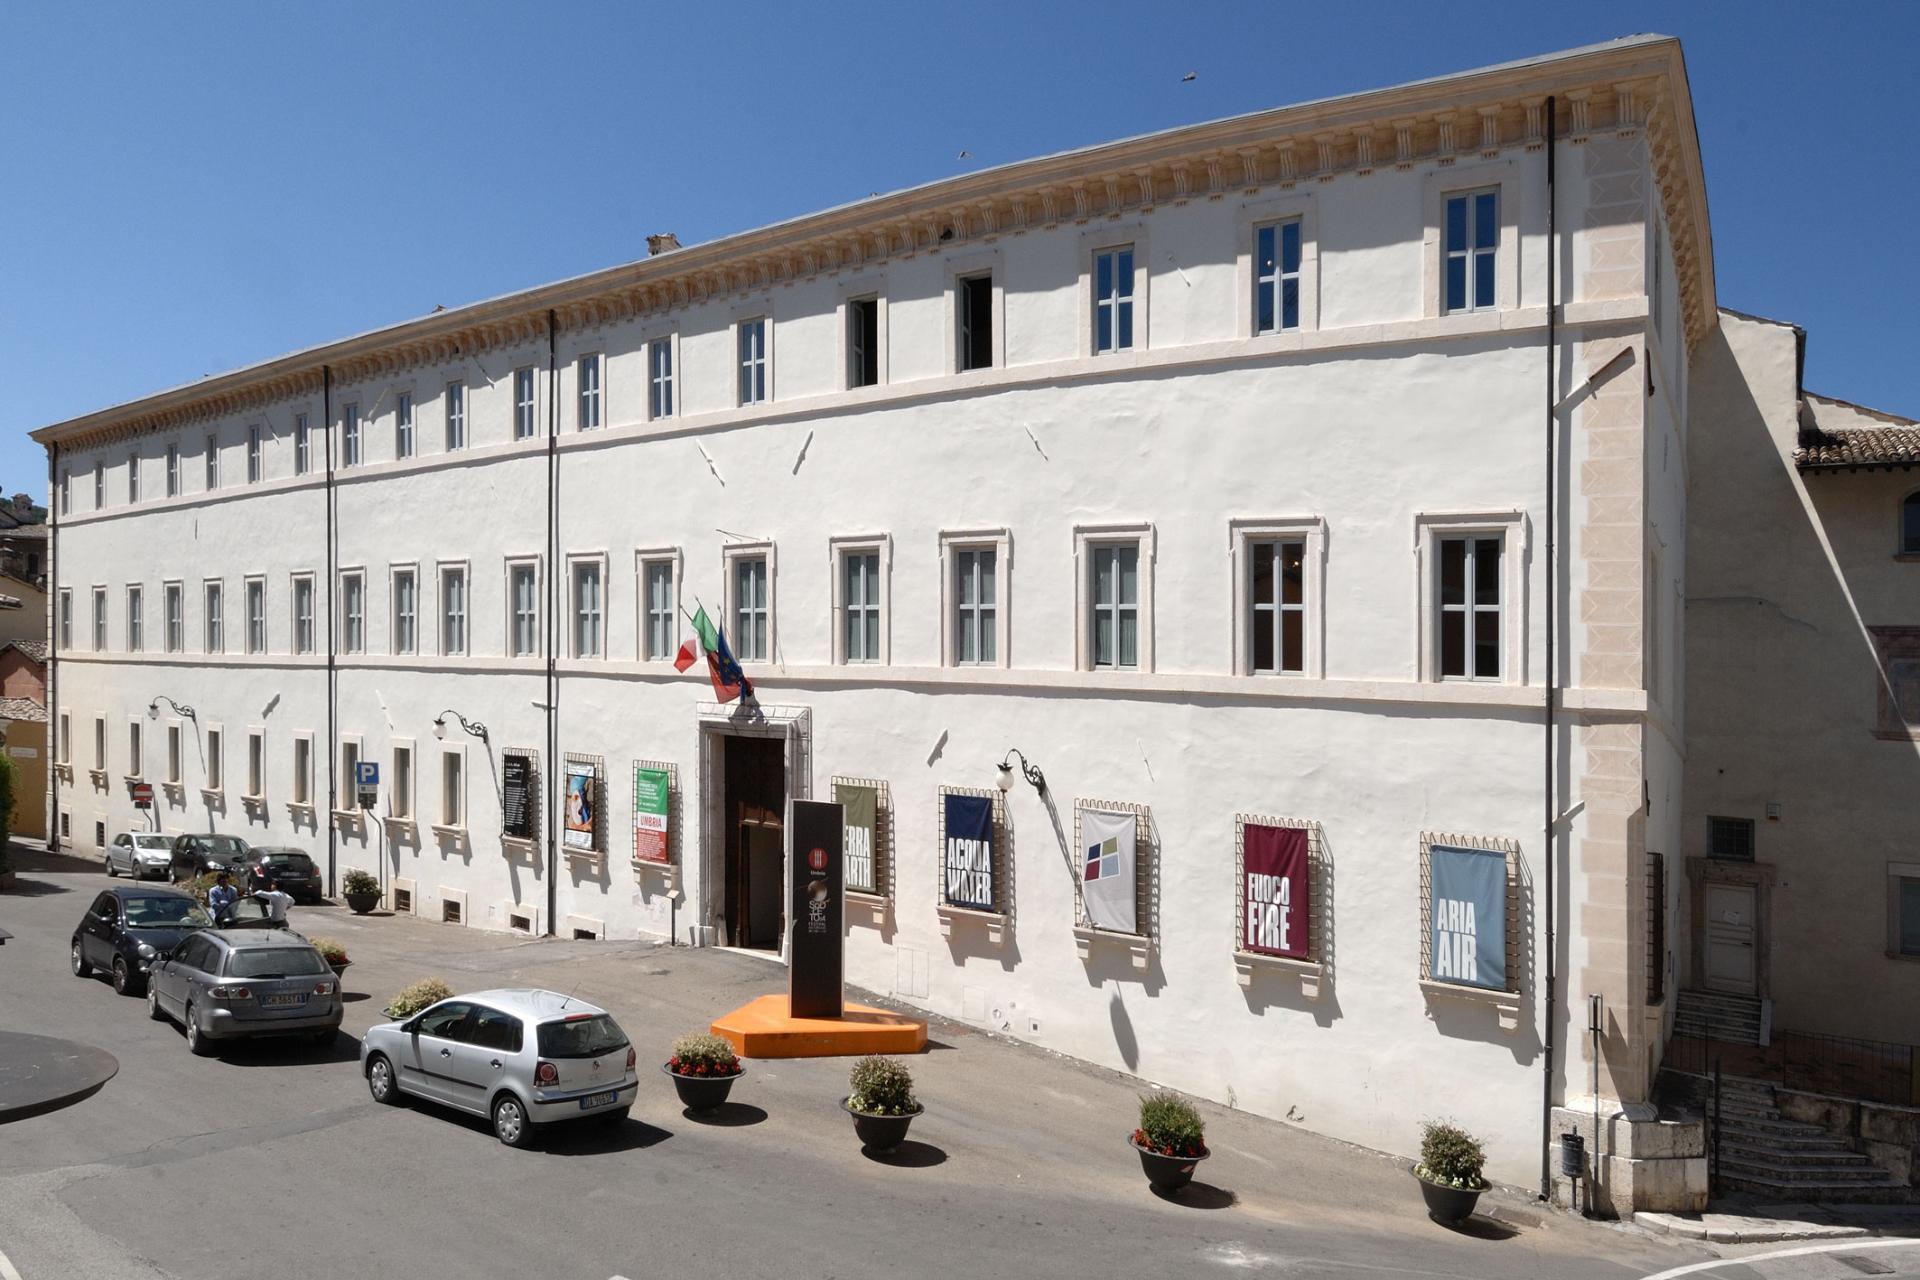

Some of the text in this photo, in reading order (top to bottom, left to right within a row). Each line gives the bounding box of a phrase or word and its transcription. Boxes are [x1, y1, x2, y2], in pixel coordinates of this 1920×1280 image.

[361, 764, 375, 782] P
[640, 815, 662, 828] UMBRIA
[845, 855, 870, 887] ARTH
[948, 838, 991, 872] ACQUA
[948, 868, 991, 904] WATER
[1248, 872, 1290, 905] FUOCO
[1248, 901, 1290, 950] FIRE
[1437, 898, 1476, 936] ARIA
[1437, 930, 1477, 981] AIR
